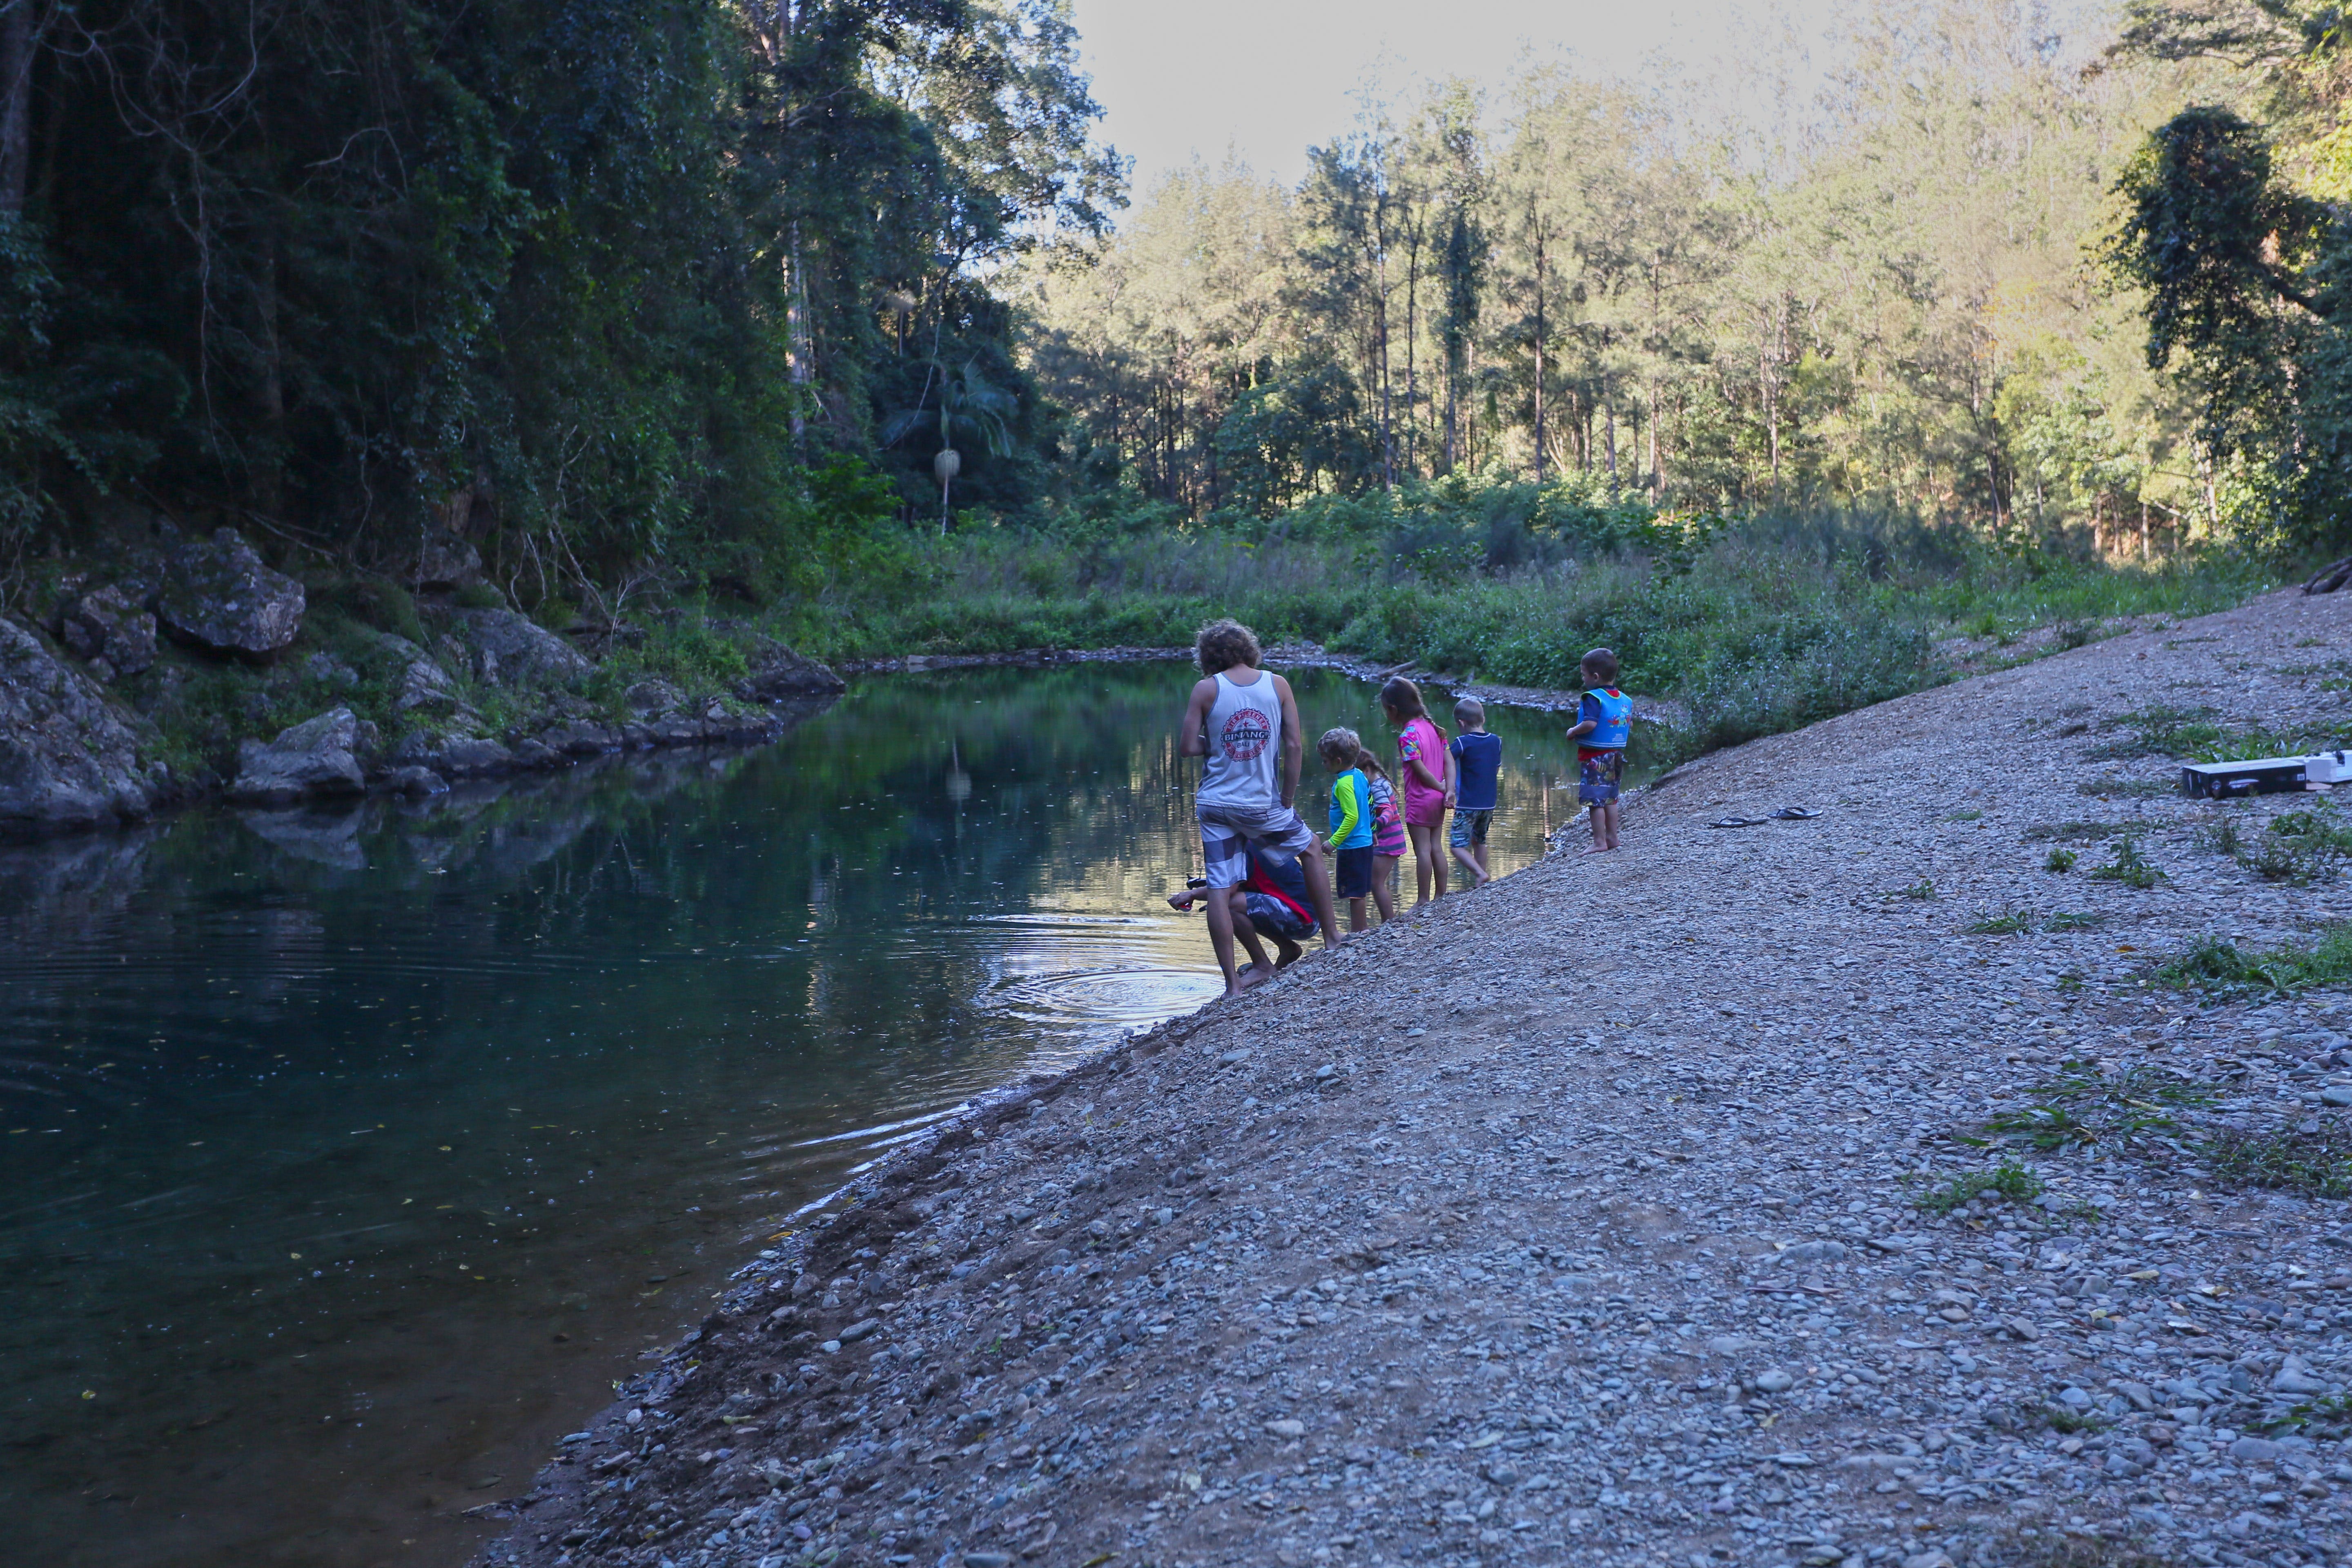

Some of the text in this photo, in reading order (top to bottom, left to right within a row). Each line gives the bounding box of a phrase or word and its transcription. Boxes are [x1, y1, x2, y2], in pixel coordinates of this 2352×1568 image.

[1227, 712, 1266, 729] BIR PILSENER
[1249, 744, 1263, 756] BEER
